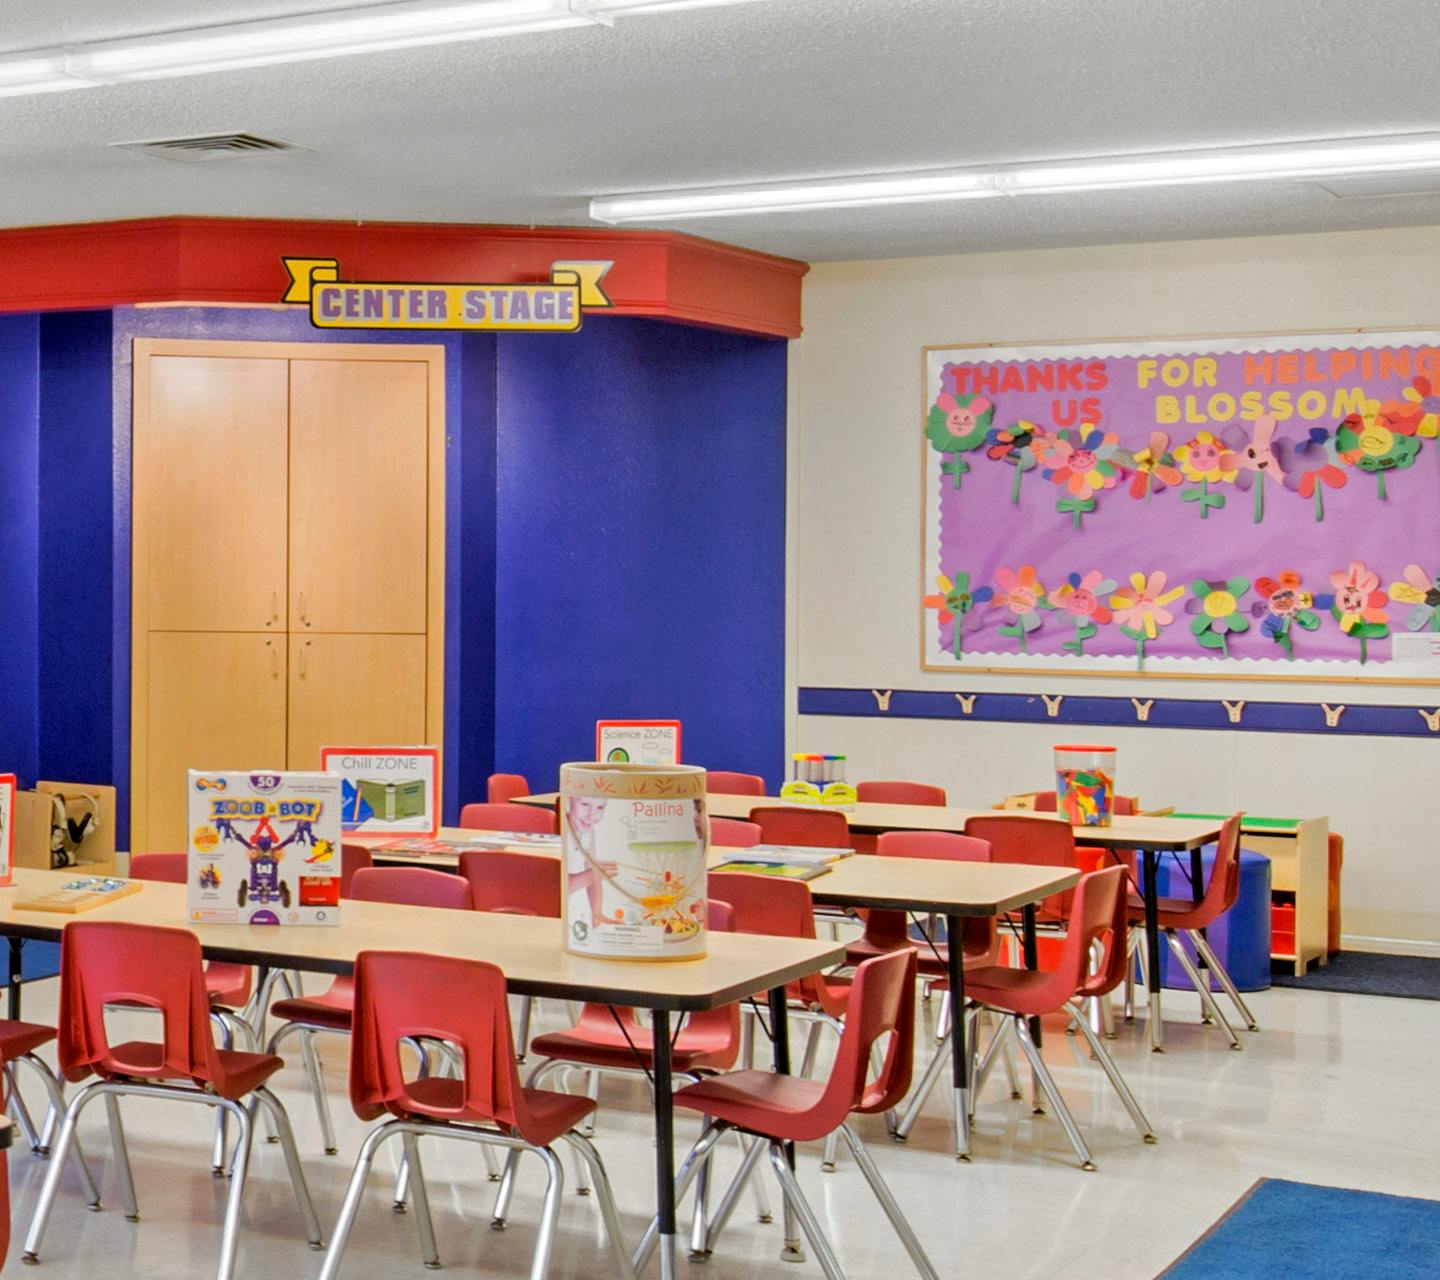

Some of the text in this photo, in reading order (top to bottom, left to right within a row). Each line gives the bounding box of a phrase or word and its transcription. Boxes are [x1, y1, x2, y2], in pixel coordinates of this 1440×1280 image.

[319, 287, 575, 323] CENTER STAGE
[951, 362, 1109, 396] THANKS
[1137, 358, 1219, 389] FOR
[1052, 385, 1368, 427] US BLOSSOM
[604, 728, 674, 739] Science ZONE
[341, 757, 418, 770] Chill ZONE
[257, 776, 275, 787] 50
[213, 801, 265, 815] ZOOB
[632, 801, 685, 817] Pallina
